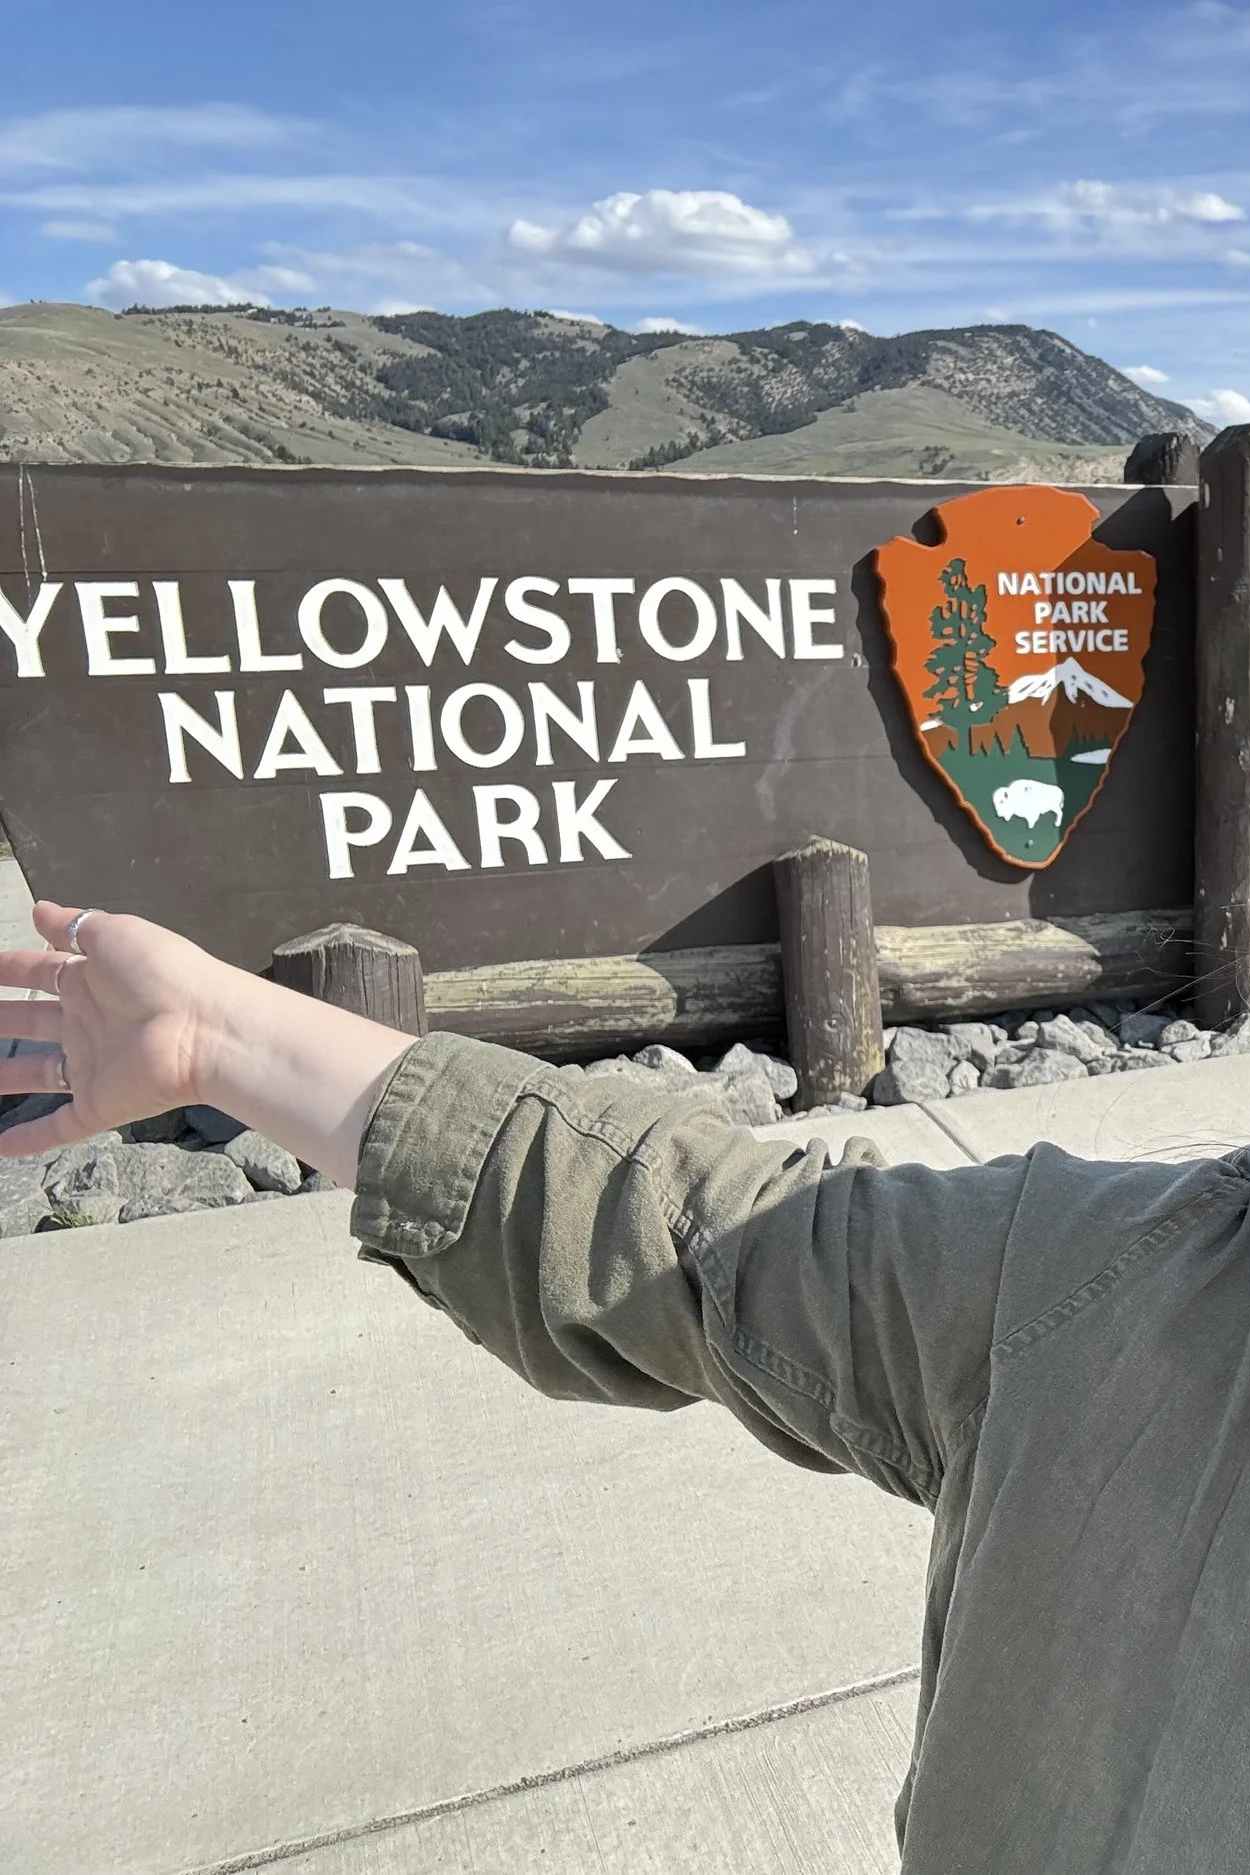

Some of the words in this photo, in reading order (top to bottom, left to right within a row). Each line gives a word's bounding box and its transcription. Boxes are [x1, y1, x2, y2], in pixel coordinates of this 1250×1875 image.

[996, 571, 1142, 596] NATIONAL
[1034, 600, 1108, 625] PARK
[0, 576, 845, 679] YELLOWSTONE
[1014, 629, 1129, 655] SERVICE
[158, 678, 747, 783] NATIONAL
[318, 778, 634, 881] PARK
